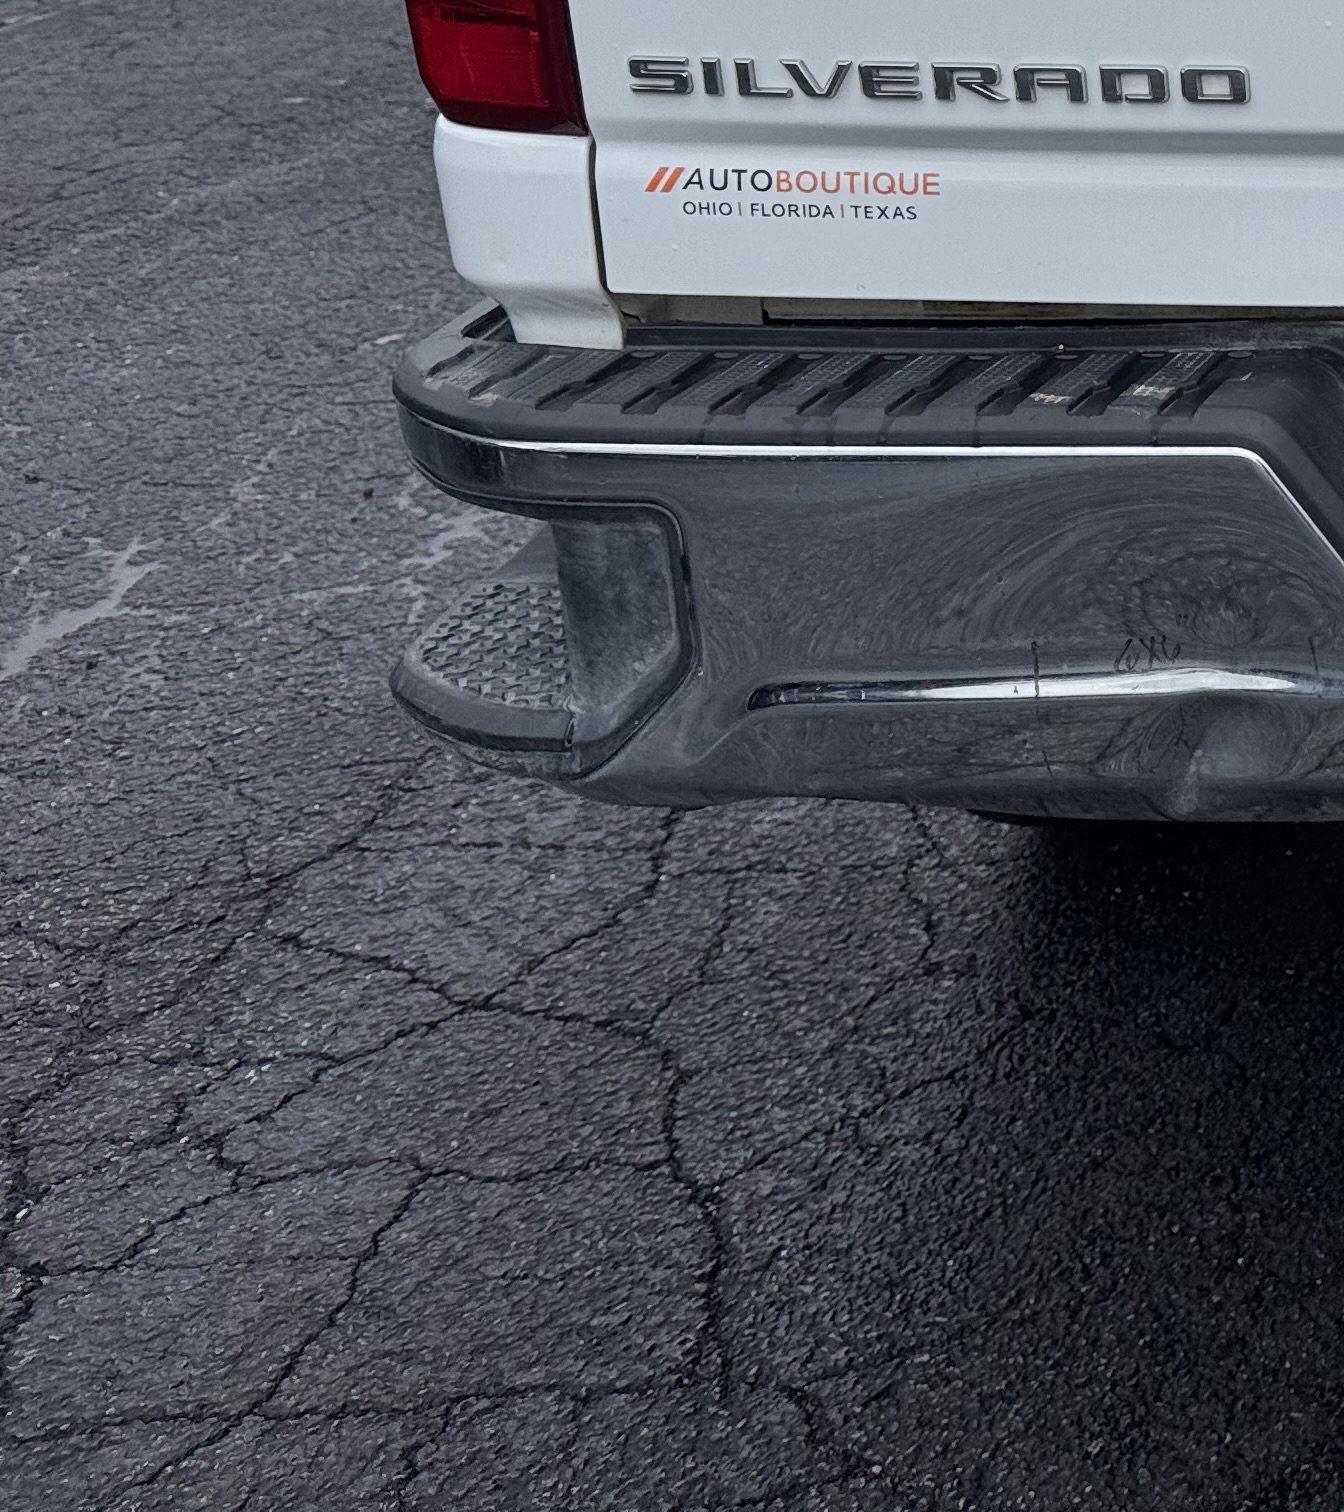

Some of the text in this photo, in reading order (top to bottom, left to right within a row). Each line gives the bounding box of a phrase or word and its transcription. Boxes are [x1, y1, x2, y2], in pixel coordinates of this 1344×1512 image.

[627, 56, 1251, 104] SILVERADO
[682, 167, 941, 196] AUTOBOUTIQUE
[682, 201, 918, 220] OHIO FLORIDA TEXAS
